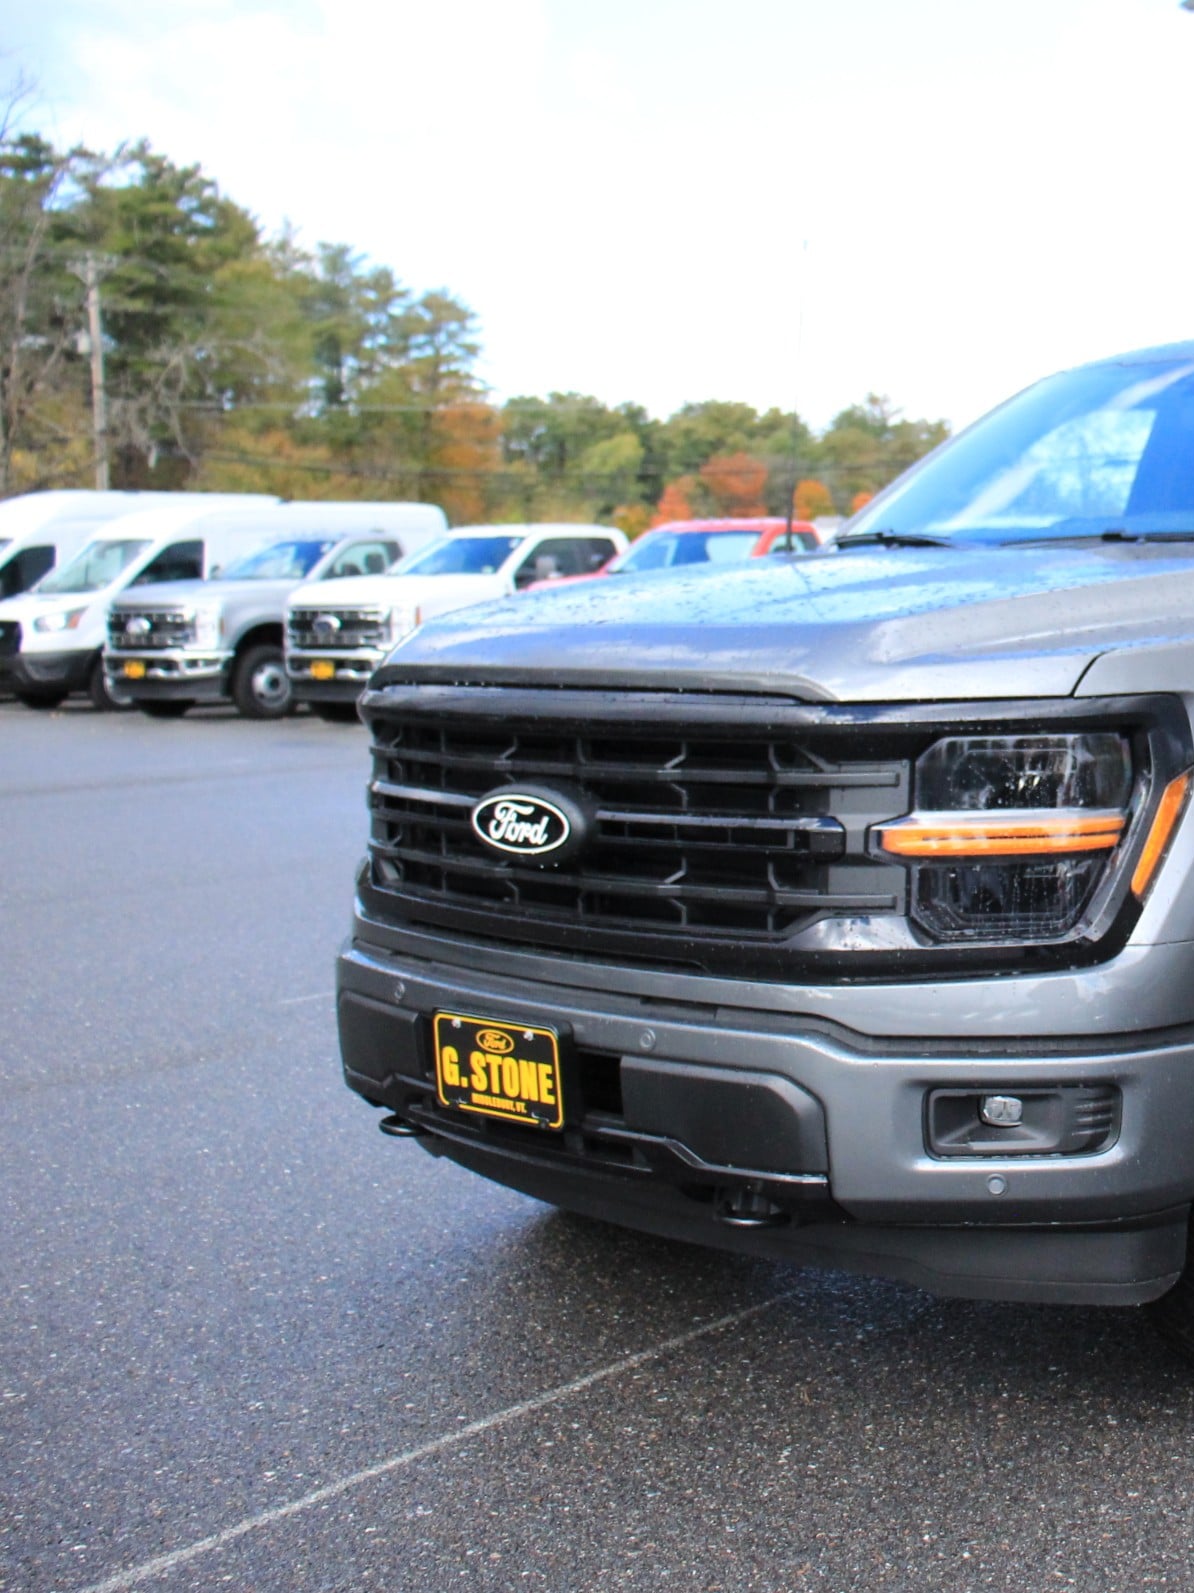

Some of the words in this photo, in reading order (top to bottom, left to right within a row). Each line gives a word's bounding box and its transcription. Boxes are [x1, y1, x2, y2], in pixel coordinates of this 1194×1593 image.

[489, 801, 549, 845] Ford
[483, 1031, 507, 1050] Ford
[442, 1046, 468, 1088] G.
[470, 1051, 556, 1105] STONE
